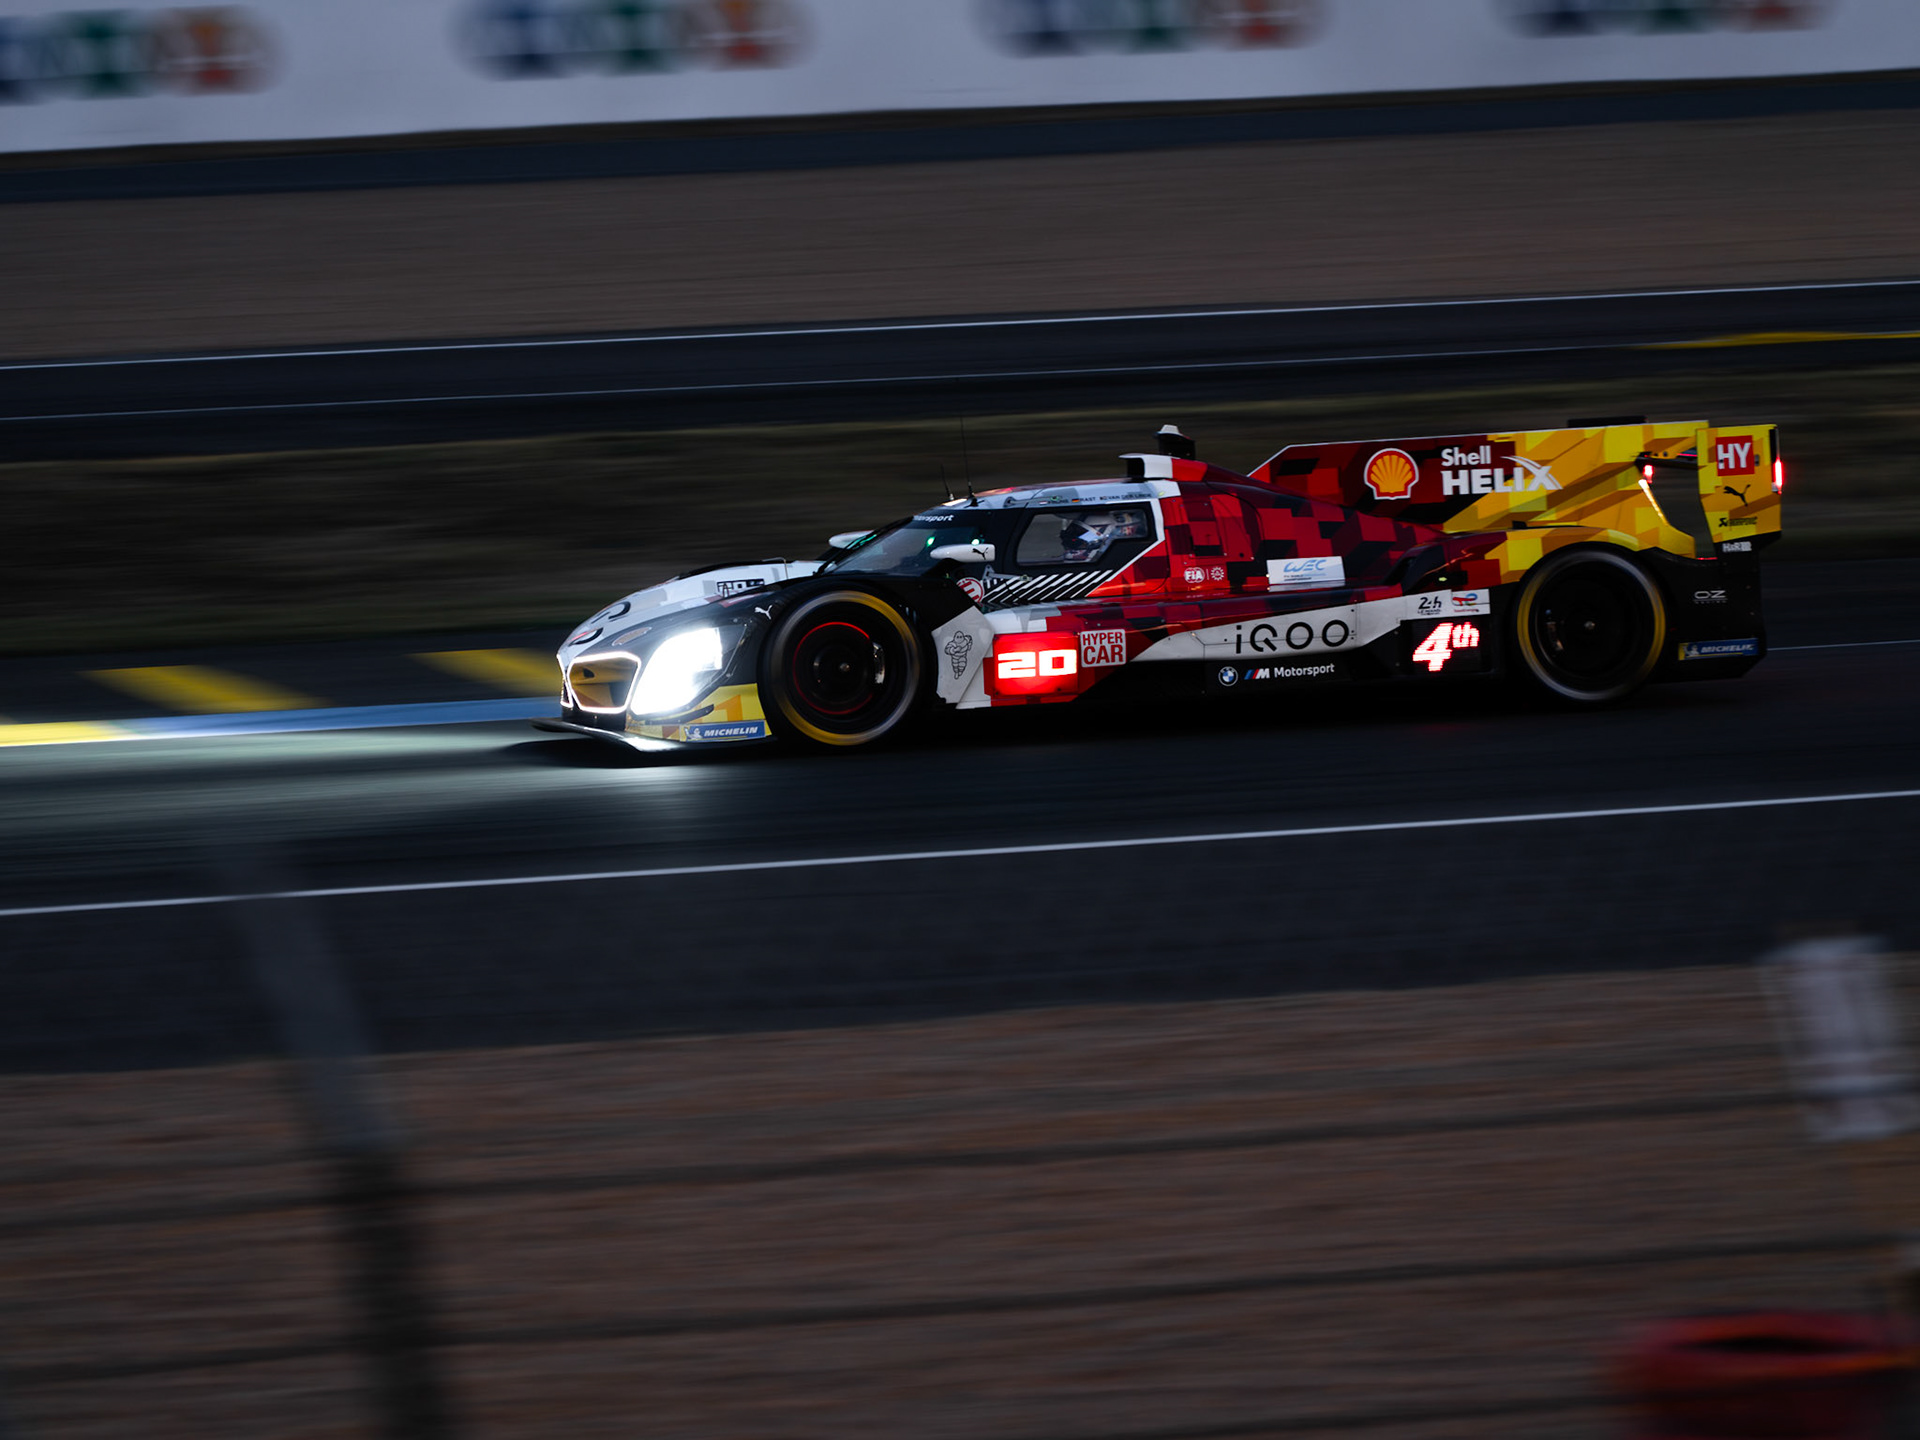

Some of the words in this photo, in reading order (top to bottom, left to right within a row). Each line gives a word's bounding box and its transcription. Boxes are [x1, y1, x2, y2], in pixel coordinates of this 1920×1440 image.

[1441, 445, 1492, 467] Shell
[1717, 441, 1752, 469] HY
[1441, 457, 1563, 496] HELIX
[1185, 569, 1204, 582] FIA
[1284, 559, 1327, 573] WEC
[1694, 590, 1727, 599] OZ
[1082, 631, 1123, 646] HYPER
[1236, 619, 1349, 654] iQOO
[1412, 621, 1480, 672] 4th
[996, 648, 1078, 680] 20
[1083, 644, 1124, 666] CAR
[1273, 663, 1336, 679] Motorsport
[703, 725, 759, 737] MICHELIN
